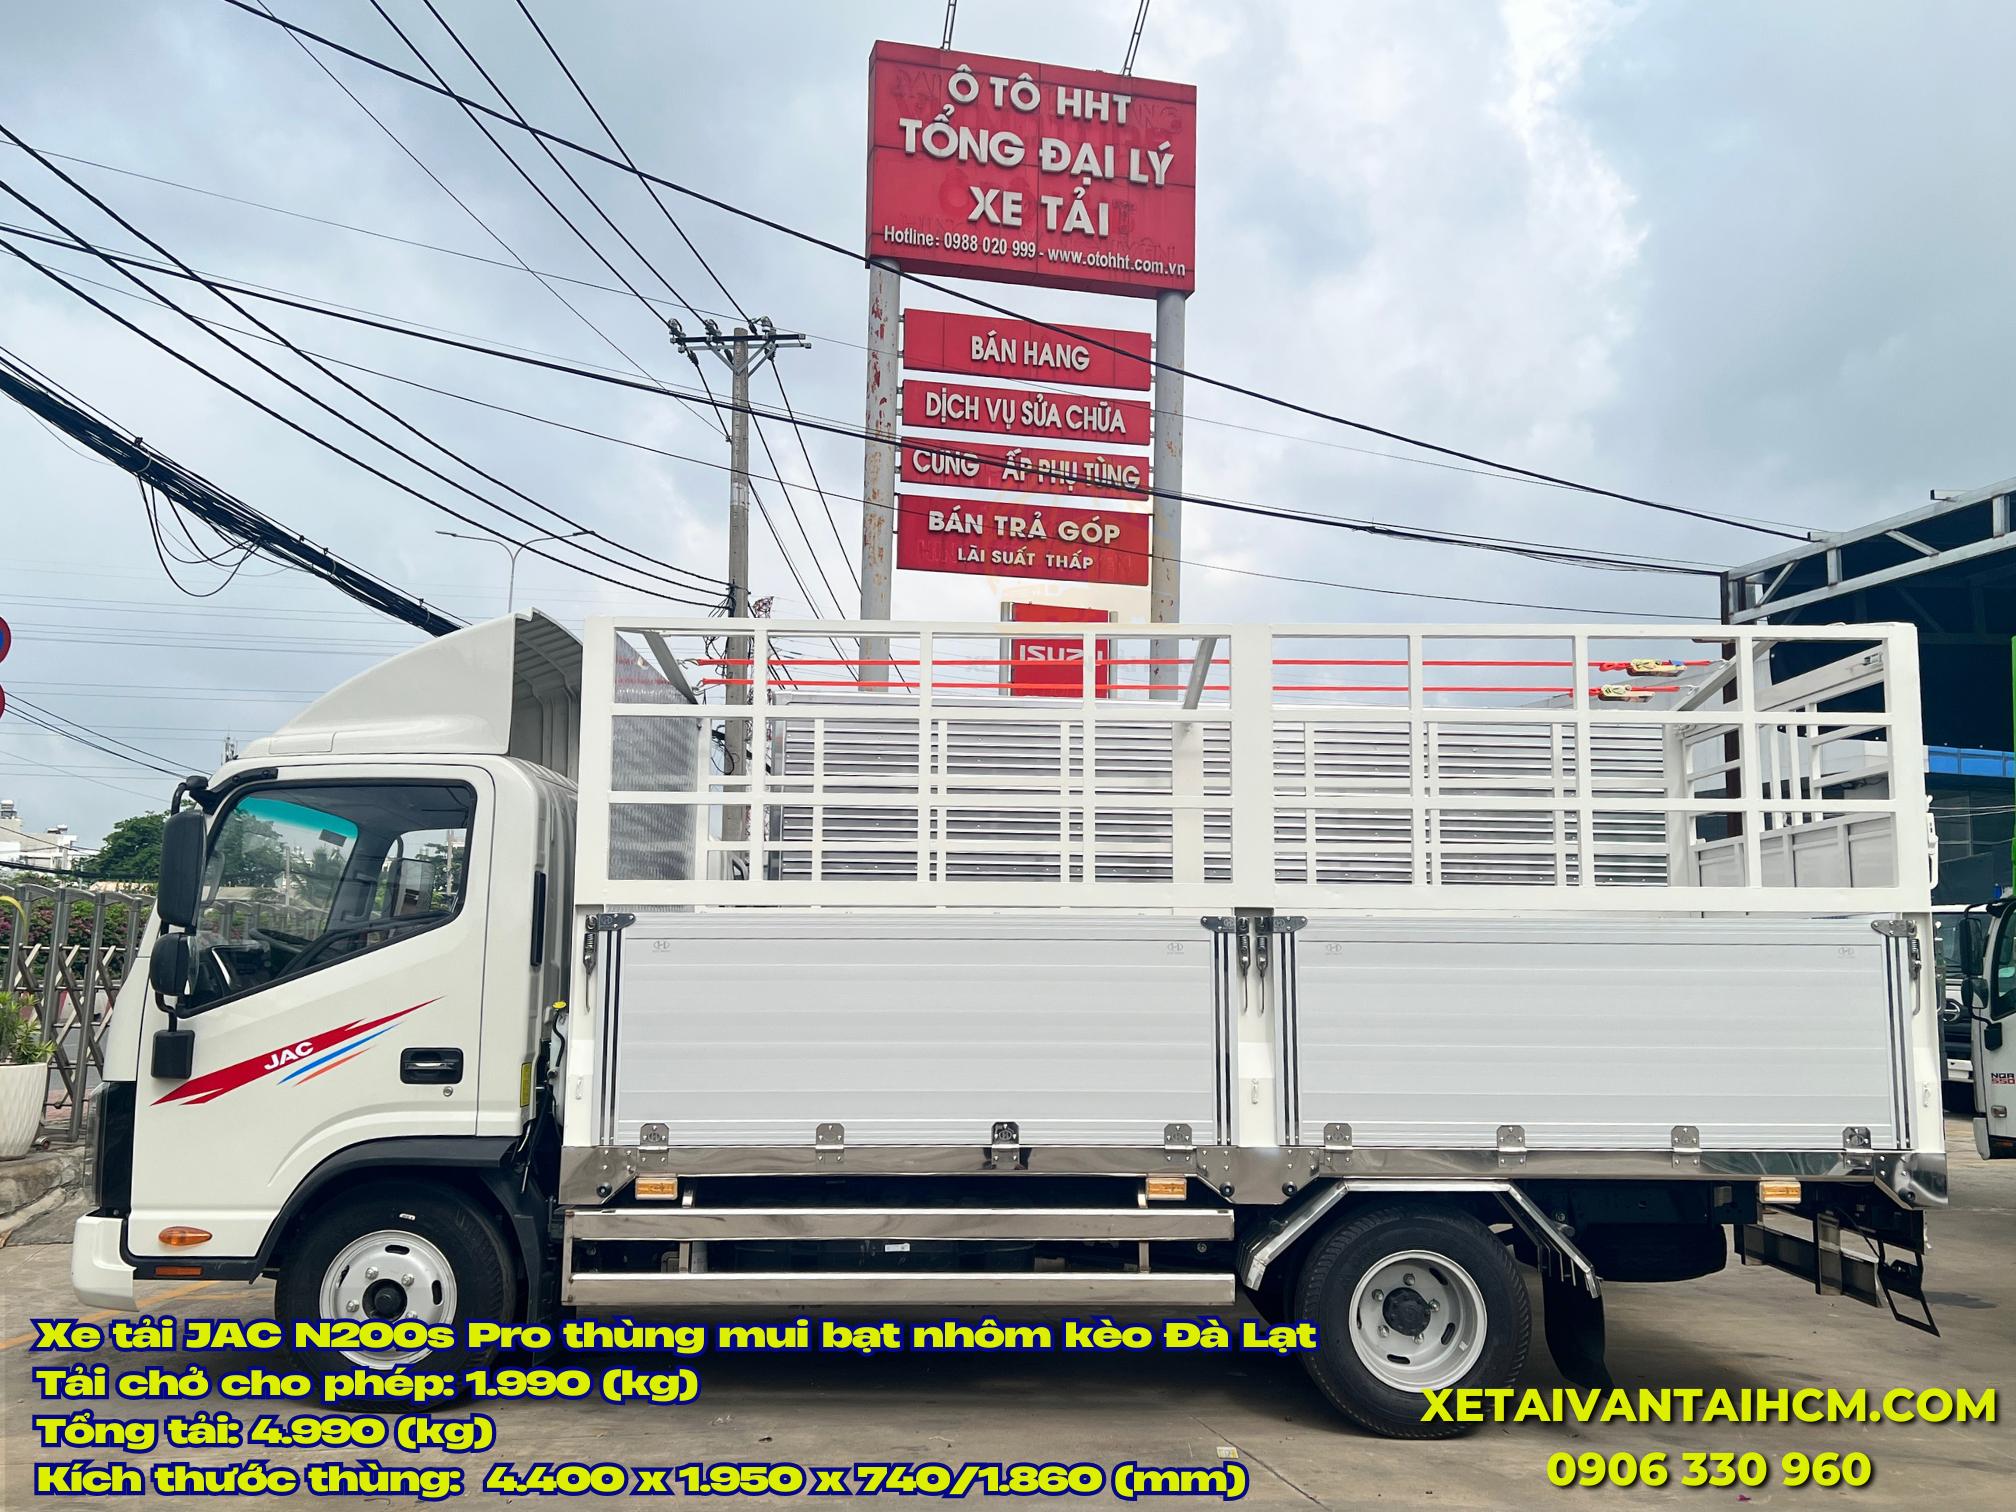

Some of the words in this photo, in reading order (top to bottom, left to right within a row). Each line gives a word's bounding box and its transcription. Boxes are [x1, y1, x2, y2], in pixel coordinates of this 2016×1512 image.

[947, 63, 980, 105] Ô
[989, 72, 1041, 113] TÔ
[1056, 85, 1132, 125] HHT
[898, 103, 1026, 168] TỔNG
[1038, 136, 1115, 187] ĐẠI
[1129, 139, 1175, 187] LÝ
[967, 185, 1023, 228] XE
[1040, 185, 1110, 238] TẢI
[884, 224, 941, 249] Hotline:
[943, 233, 977, 253] 0988
[981, 237, 1008, 256] 020
[1011, 240, 1037, 259] 999
[1047, 246, 1187, 277] www.otohht.com.vn
[970, 329, 1017, 365] BÁN
[1023, 341, 1090, 372] HANG
[925, 386, 979, 424] DỊCH
[985, 396, 1016, 430] VỤ
[1021, 394, 1063, 430] SỬA
[1065, 401, 1127, 435] CHỮA
[912, 449, 980, 478] CUNG
[1037, 458, 1078, 492] PHỤ
[1082, 456, 1141, 490] TÙNG
[927, 504, 984, 536] BÁN
[993, 511, 1048, 540] TRẢ
[1057, 515, 1121, 545] GÓP
[956, 544, 986, 563] LÃI
[990, 546, 1036, 567] SUẤT
[1045, 549, 1095, 571] THẤP
[263, 1041, 315, 1071] JAC
